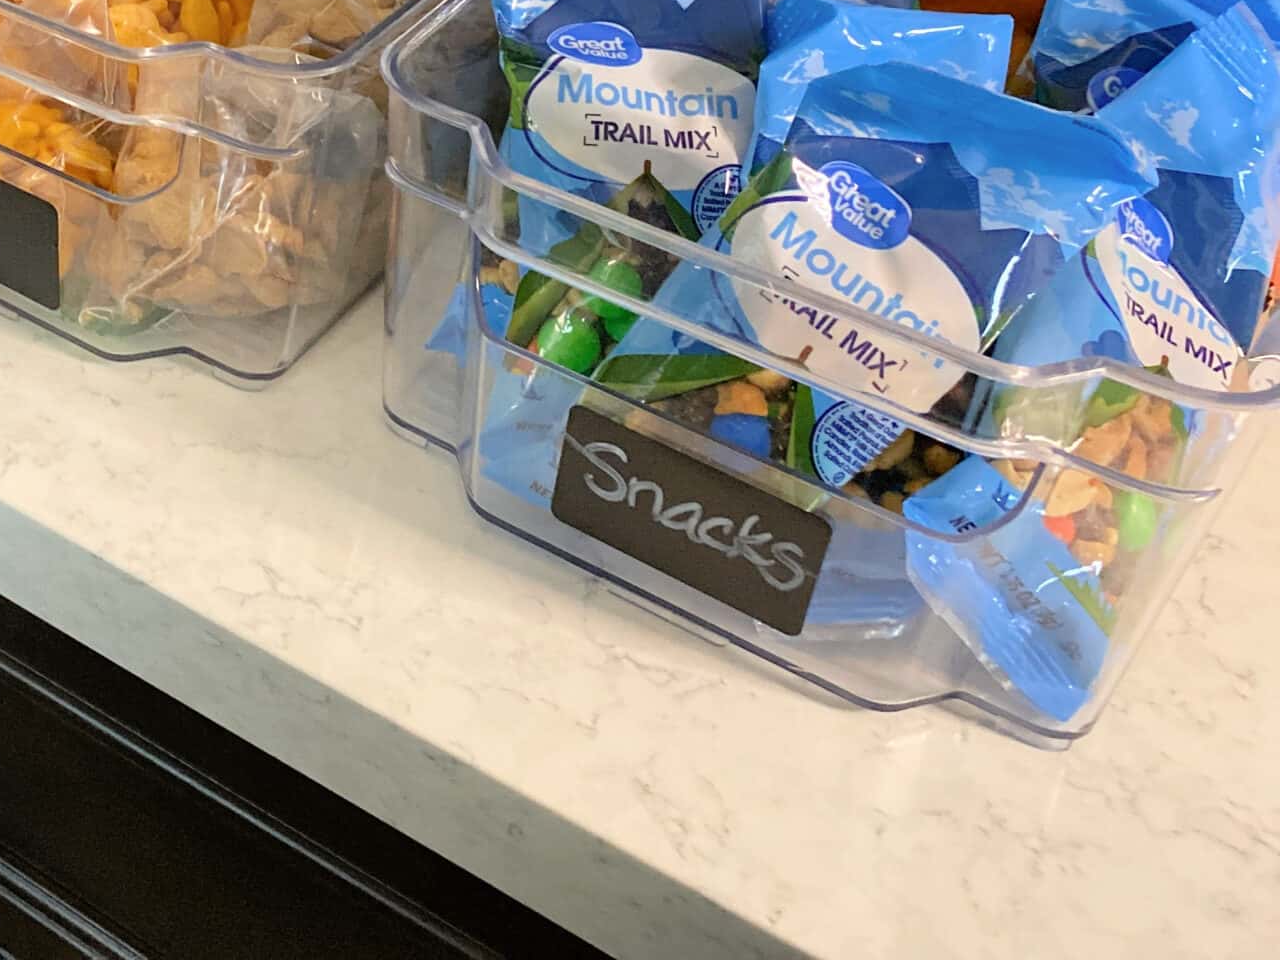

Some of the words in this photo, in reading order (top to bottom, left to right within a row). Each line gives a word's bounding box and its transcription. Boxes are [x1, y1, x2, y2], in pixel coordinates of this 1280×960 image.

[558, 34, 626, 52] Great
[557, 72, 739, 120] Mountain
[590, 120, 658, 146] TRAIL
[664, 128, 712, 152] MIX
[831, 170, 897, 228] Great
[834, 195, 884, 240] Value
[769, 210, 948, 369] Mountai
[838, 329, 897, 379] MIX
[1124, 291, 1178, 347] TRAIL
[1185, 335, 1233, 381] MIX
[583, 441, 806, 591] Snacks
[949, 515, 978, 534] NE
